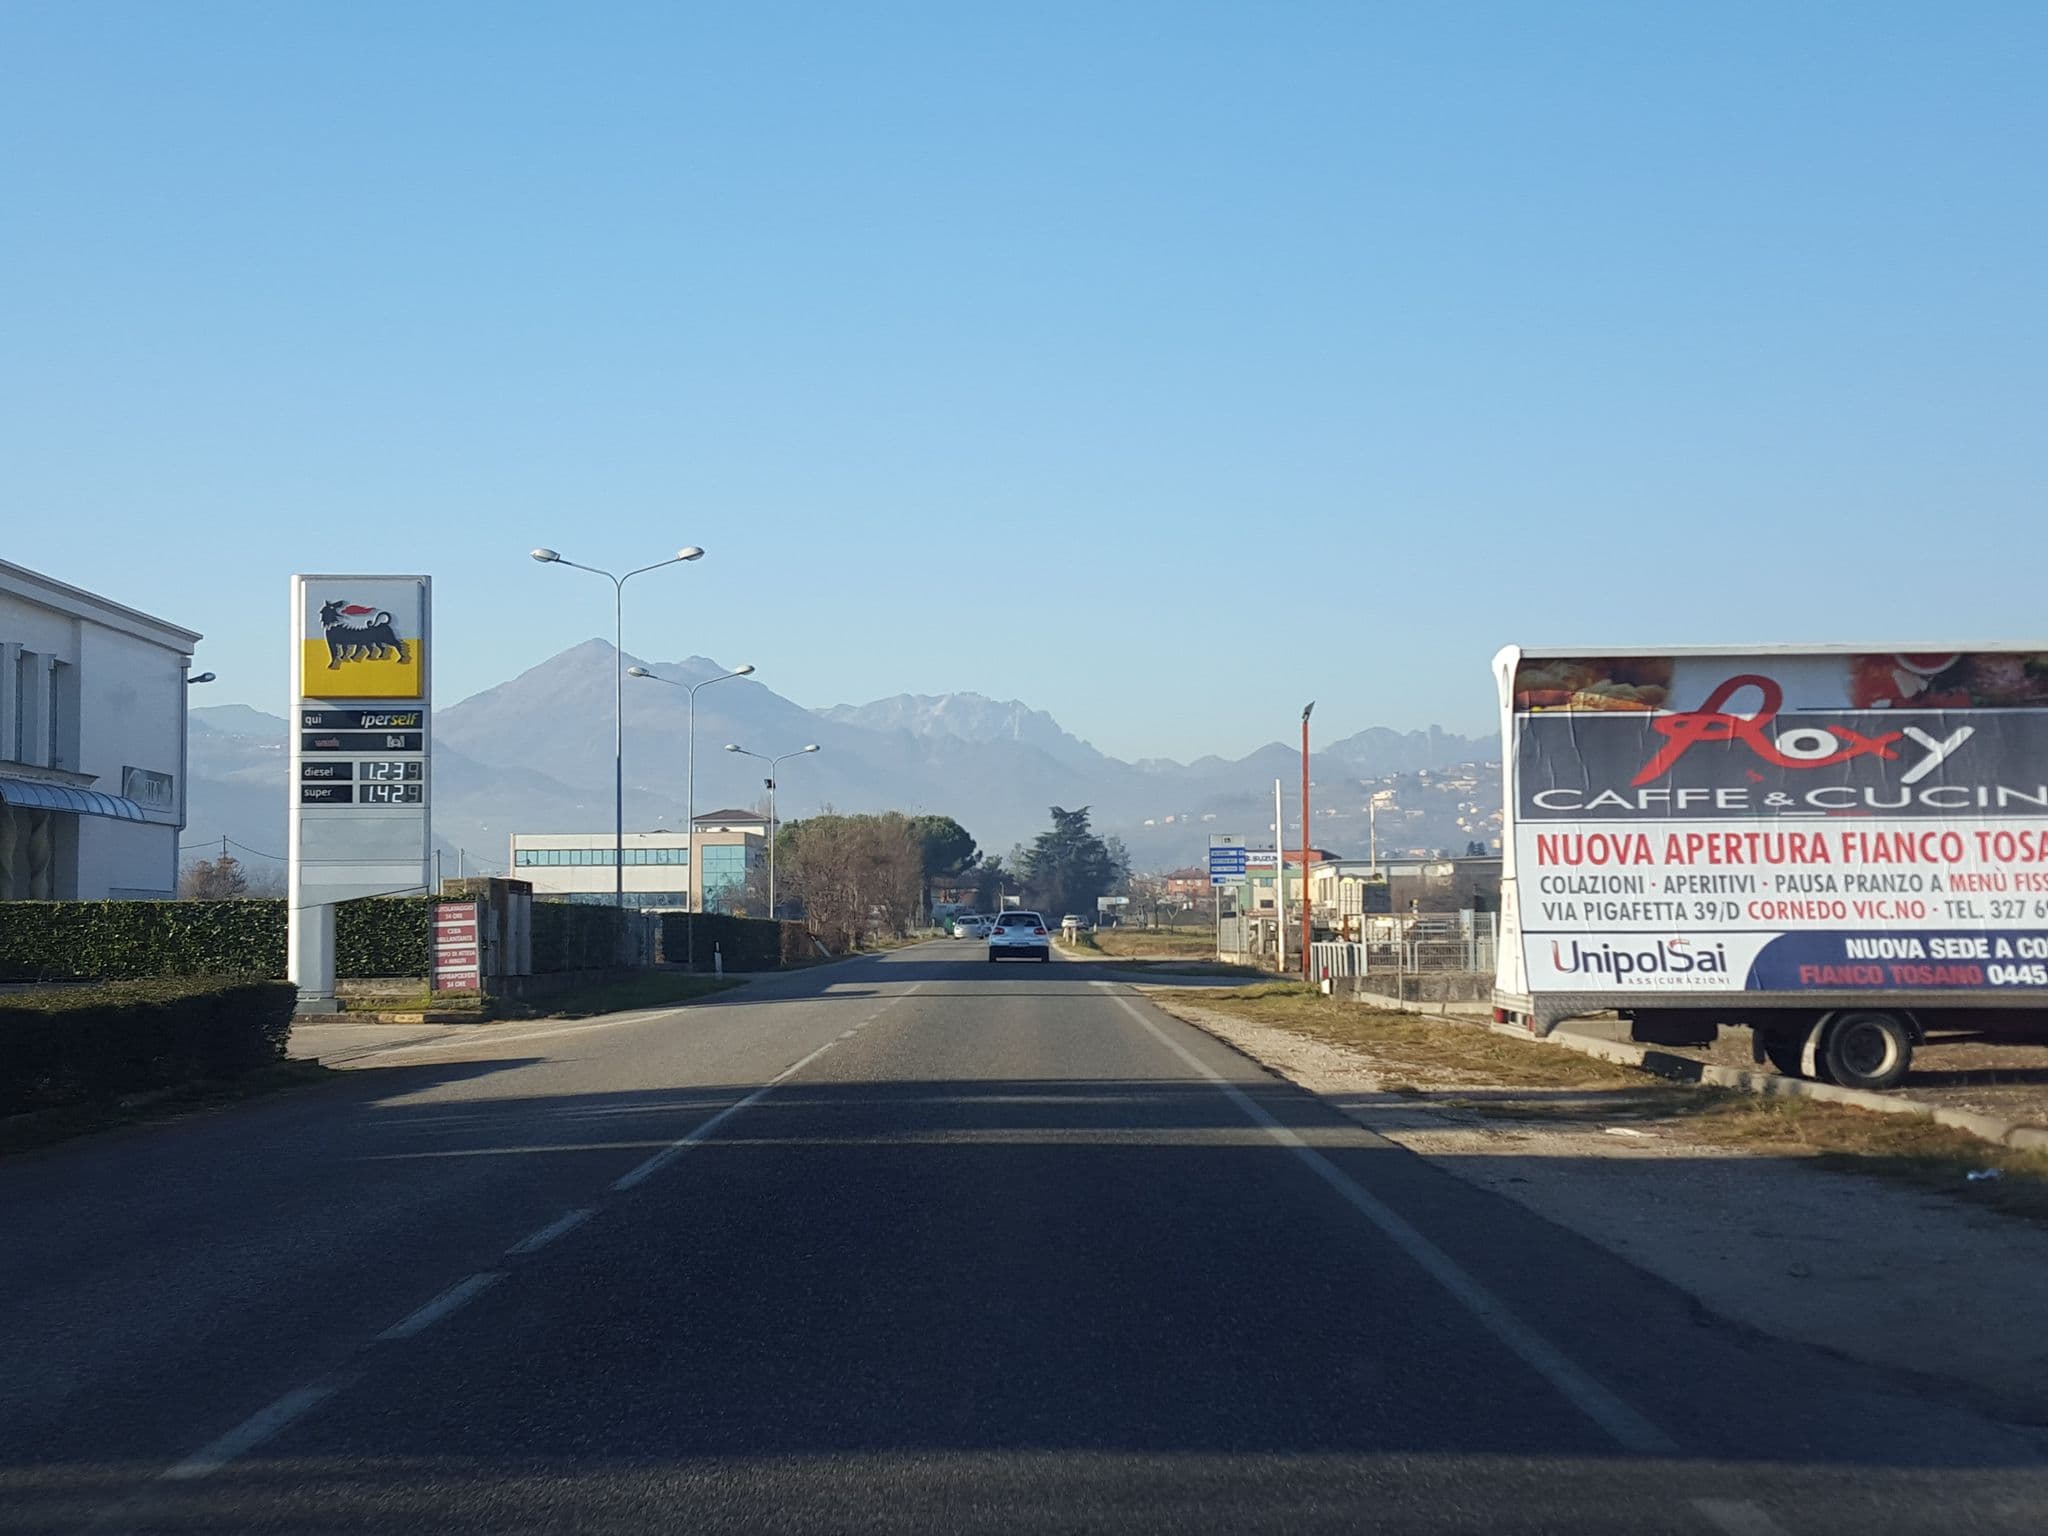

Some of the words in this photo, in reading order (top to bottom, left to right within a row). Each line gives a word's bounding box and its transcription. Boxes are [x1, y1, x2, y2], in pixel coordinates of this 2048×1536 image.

[304, 713, 322, 726] qui
[360, 711, 419, 729] iperself
[304, 767, 334, 776] diesel
[304, 789, 332, 798] super
[1532, 788, 1749, 810] CAFFE
[1764, 792, 1796, 807] &
[1805, 786, 2048, 810] CUCIN
[1536, 833, 1655, 866] NUOVA
[1664, 832, 1831, 866] APERTURA
[1841, 830, 1965, 865] FIANCO
[1975, 829, 2048, 864] TOSA
[1540, 874, 1645, 894] COLAZIONI
[1663, 873, 1756, 894] APERITIVI
[1775, 873, 1838, 893] PAUSA
[1844, 873, 1924, 893] PRANZO
[1930, 873, 1943, 893] A
[1949, 866, 2008, 892] MENÙ
[1542, 902, 1578, 921] VIA
[1583, 901, 1688, 921] PIGAFETTA
[1694, 901, 1740, 922] 39/D
[1748, 900, 1847, 920] CORNEDO
[1853, 900, 1926, 919] VIC.NO
[1944, 900, 1984, 919] TEL.
[1990, 899, 2027, 919] 327
[2035, 899, 2048, 918] 6
[1845, 938, 1927, 959] NUOVA
[1929, 938, 1991, 959] SEDE
[1995, 938, 2015, 959] A
[1551, 938, 1728, 985] UnipolSai
[1628, 977, 1731, 986] ASSICURAZIONI
[1799, 964, 1885, 986] FIANCO
[1888, 964, 1984, 986] TOSANO
[1986, 964, 2048, 985] 0445
